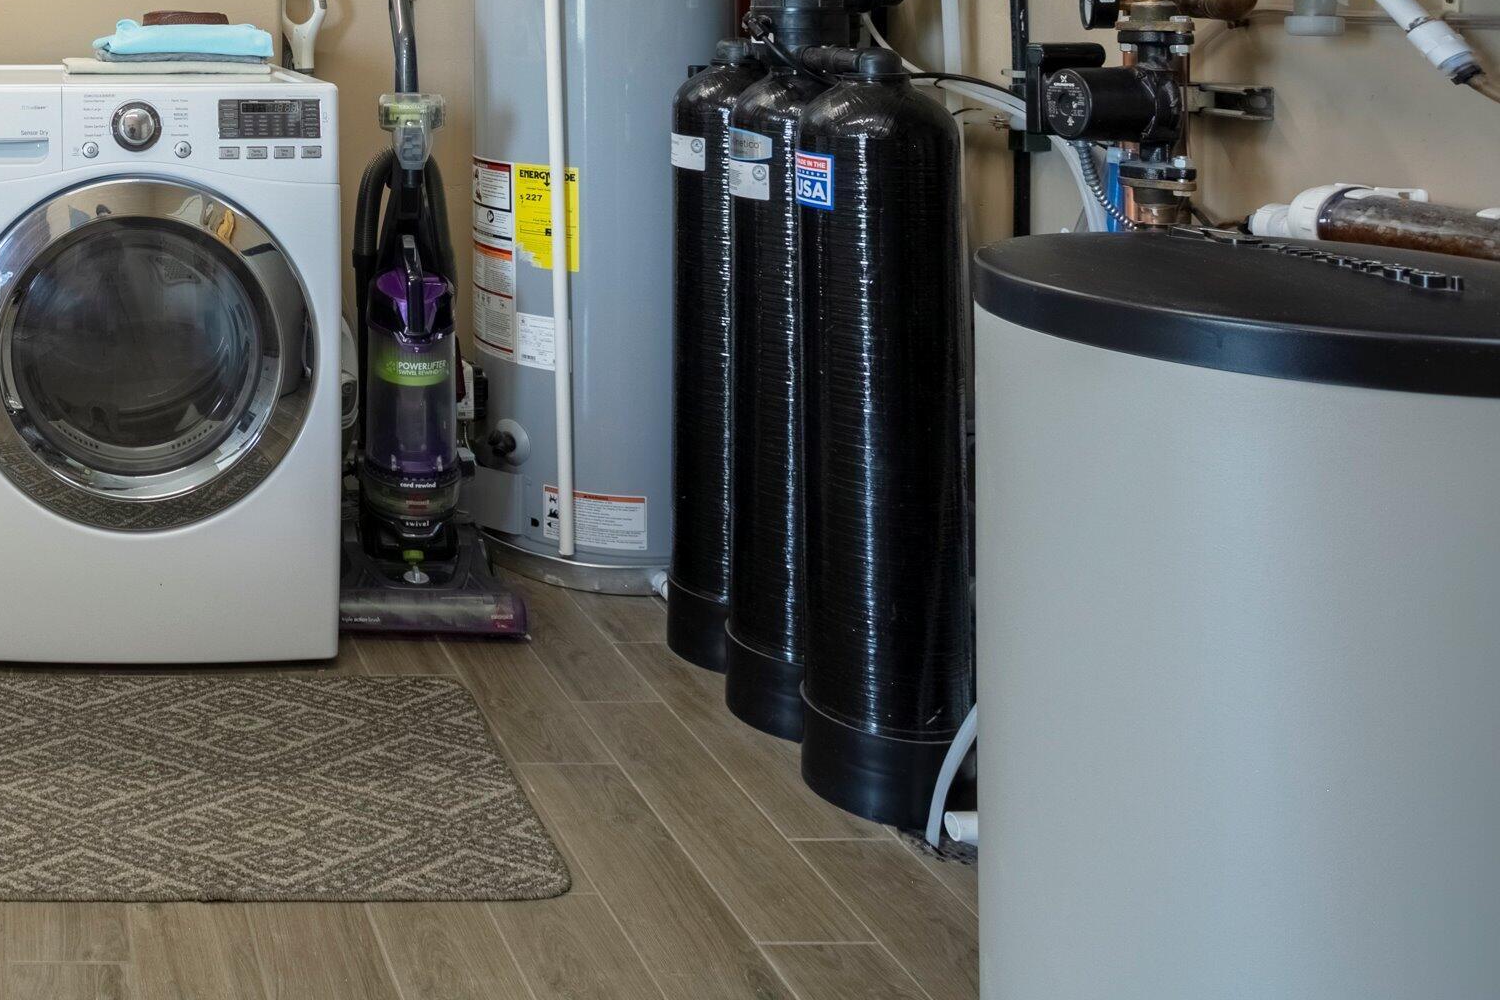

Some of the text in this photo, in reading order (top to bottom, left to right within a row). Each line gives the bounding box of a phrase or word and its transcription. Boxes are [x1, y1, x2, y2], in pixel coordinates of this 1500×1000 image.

[797, 177, 826, 200] USA
[526, 193, 543, 202] 227
[398, 360, 446, 370] POWERLIFTER
